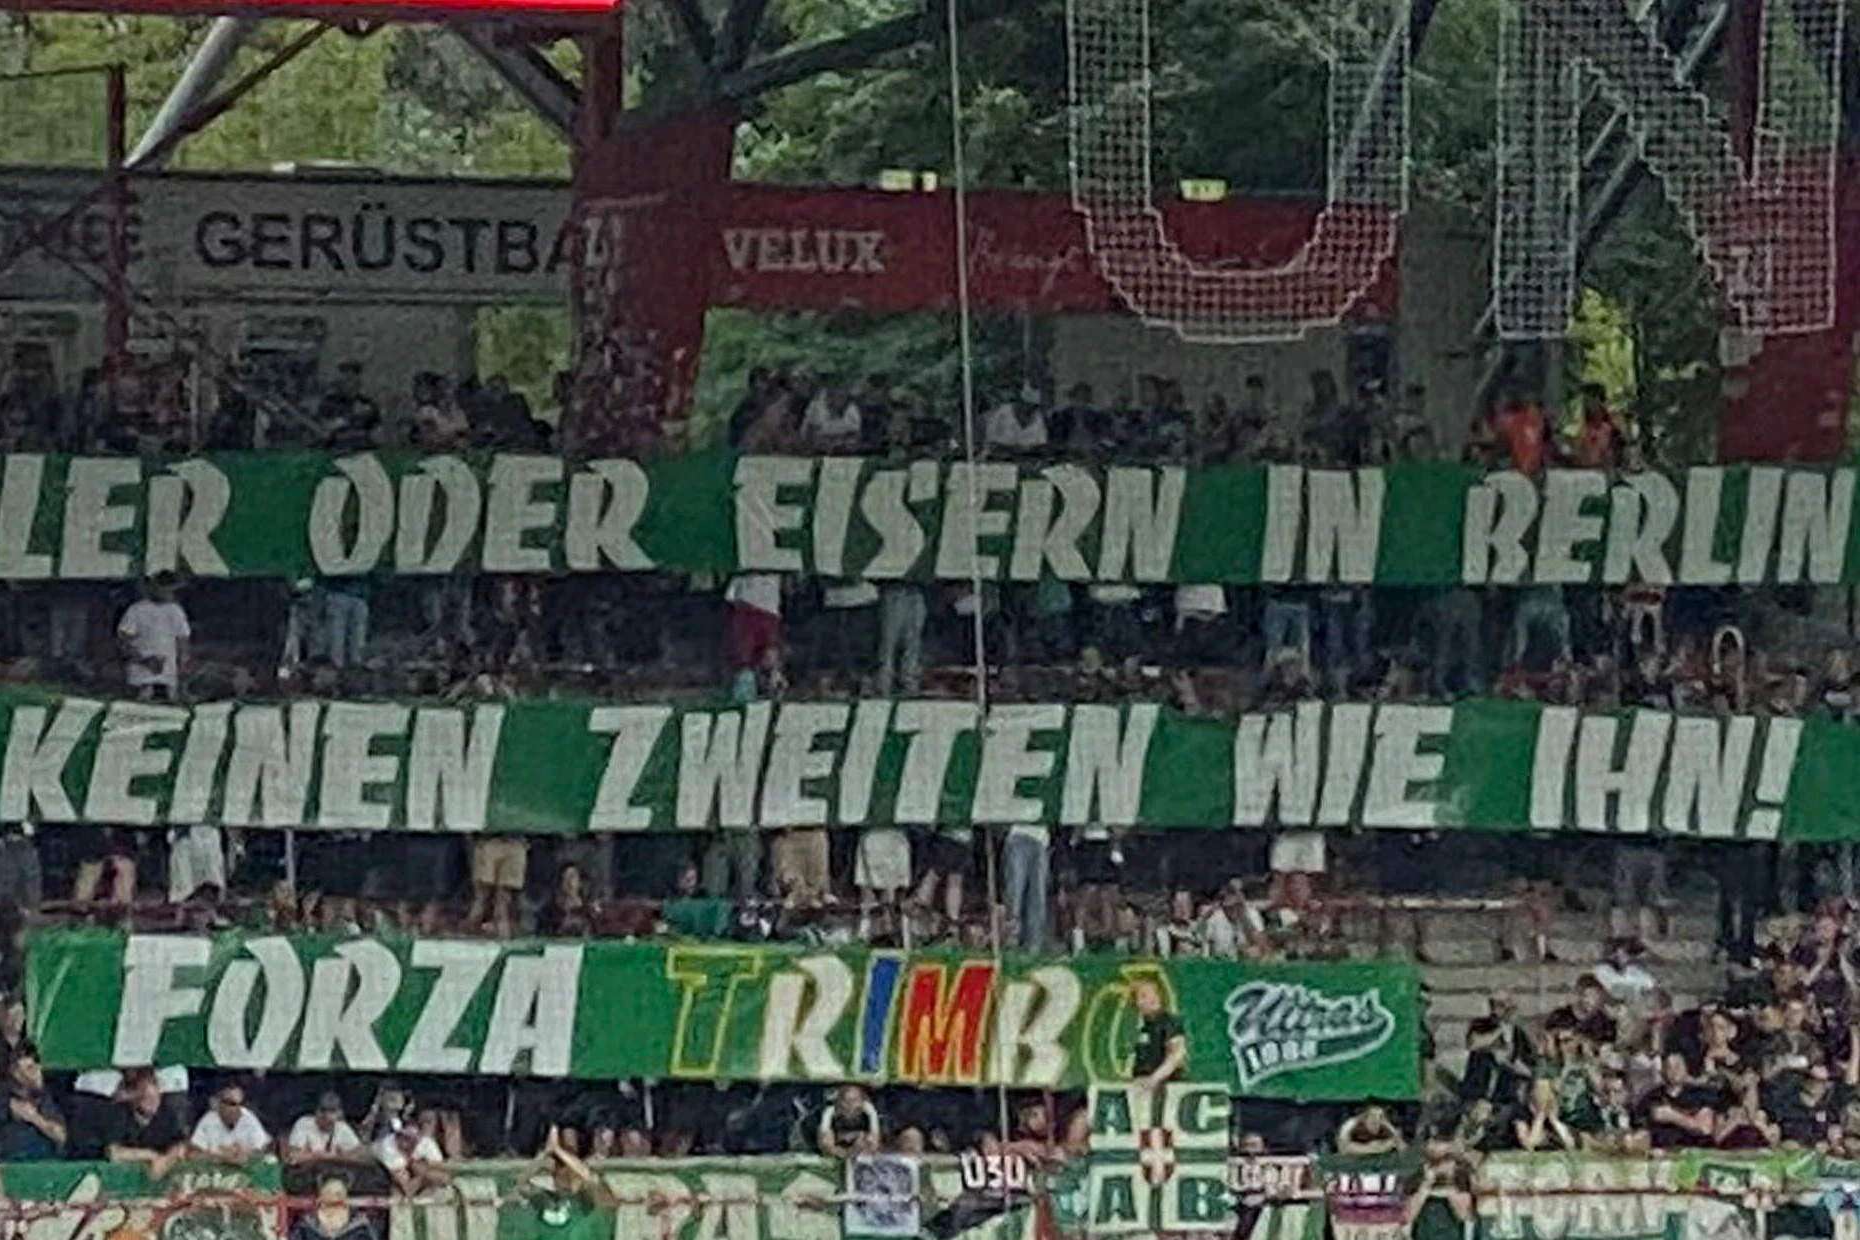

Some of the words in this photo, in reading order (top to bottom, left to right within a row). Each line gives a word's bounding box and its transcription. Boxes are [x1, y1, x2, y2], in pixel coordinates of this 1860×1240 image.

[720, 228, 886, 273] VELUX
[308, 453, 658, 577] ODER
[731, 455, 1188, 582] EISERN
[1260, 465, 1387, 583] IN
[1460, 466, 1858, 587] BERLIN
[587, 699, 1162, 831] ZWEITEN
[1232, 699, 1454, 831] WIE
[1528, 704, 1805, 840] IHN!
[110, 934, 585, 1076] FORZA
